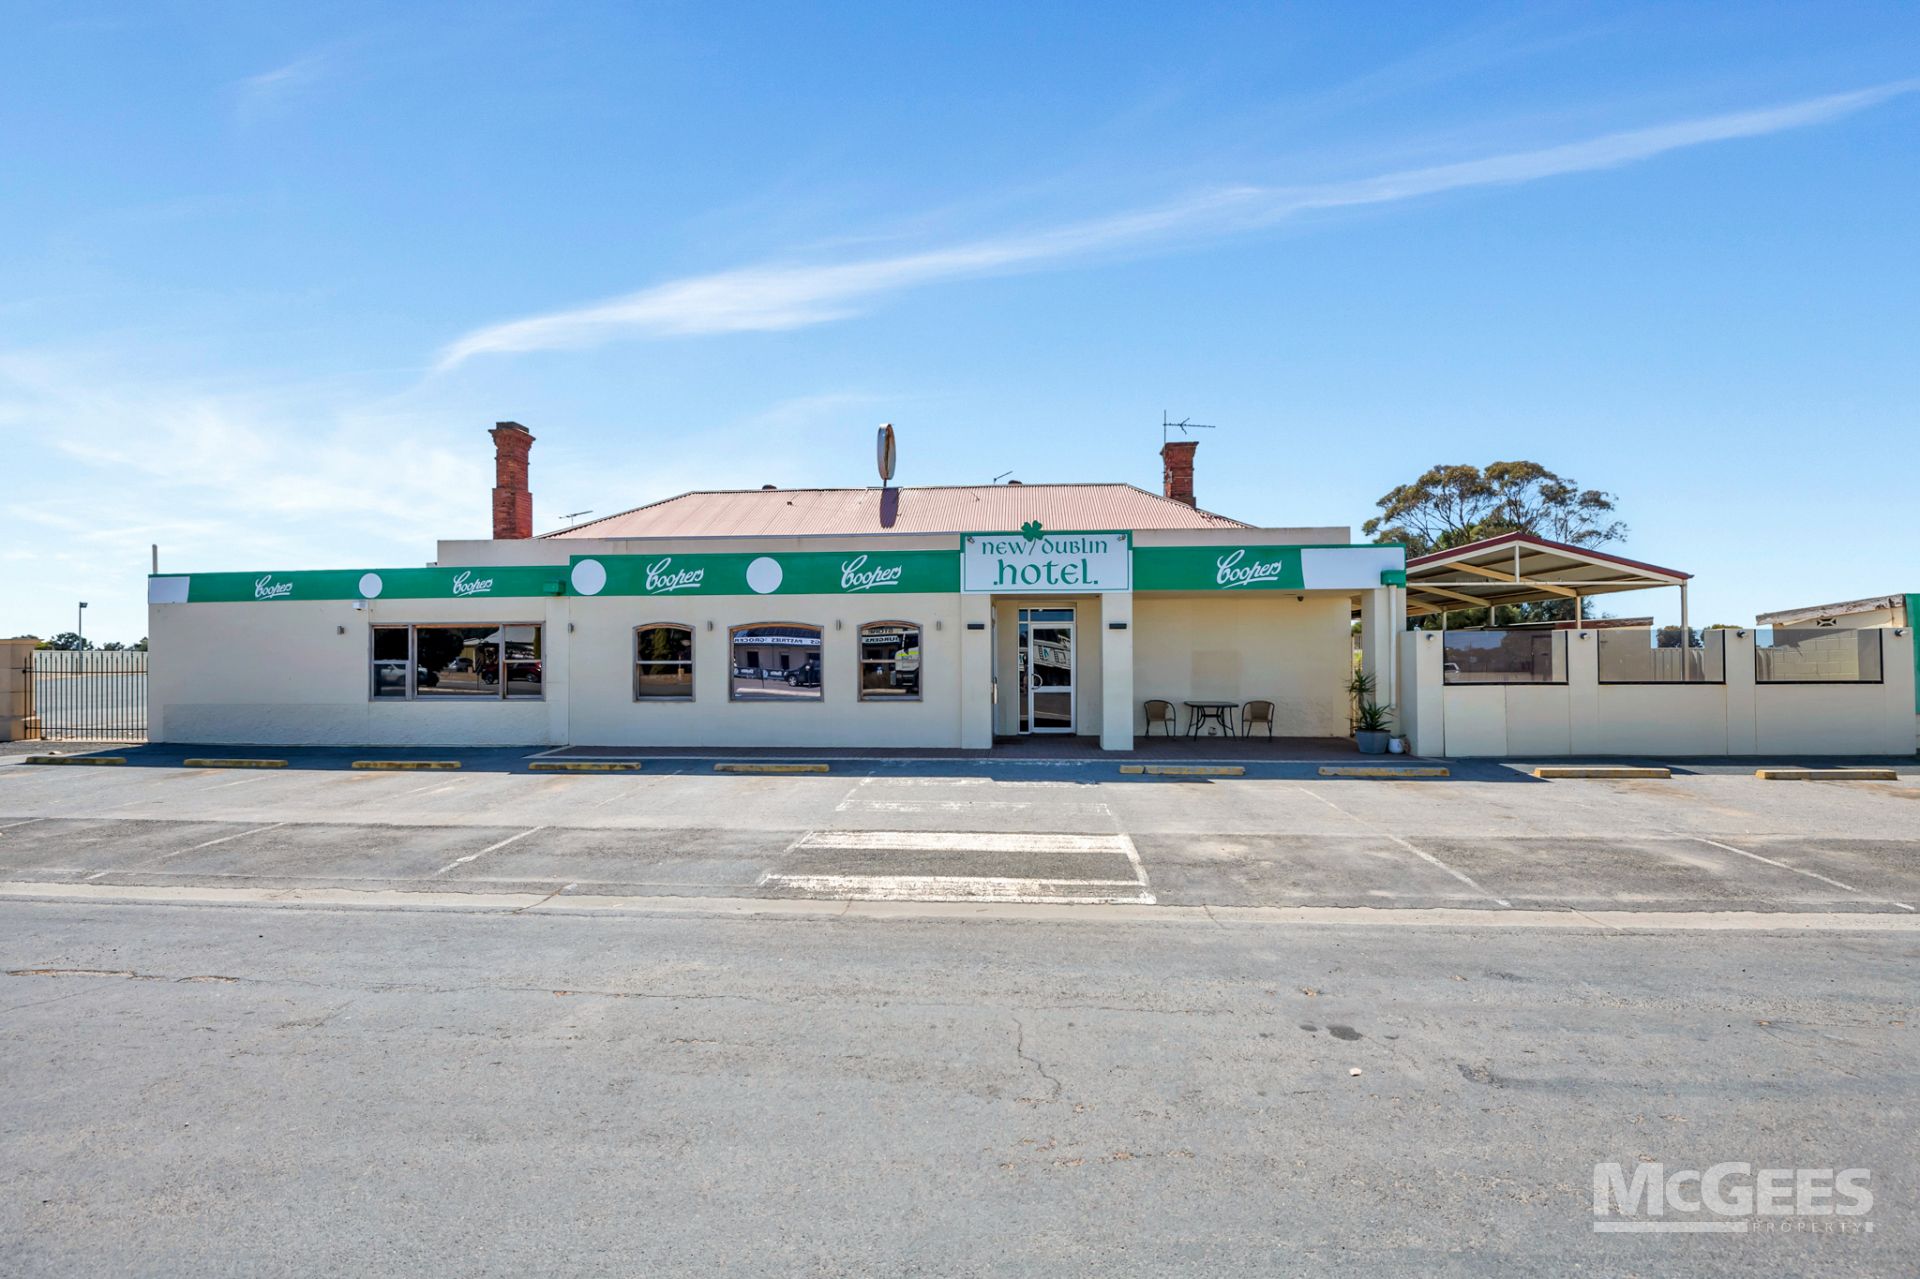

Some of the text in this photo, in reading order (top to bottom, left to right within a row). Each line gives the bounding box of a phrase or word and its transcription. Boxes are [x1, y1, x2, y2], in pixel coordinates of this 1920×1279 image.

[453, 570, 493, 595] Coopers
[645, 557, 704, 592] Coopers
[841, 554, 902, 590] Coopers
[1216, 549, 1282, 586] Coopers
[255, 574, 293, 599] Coopers
